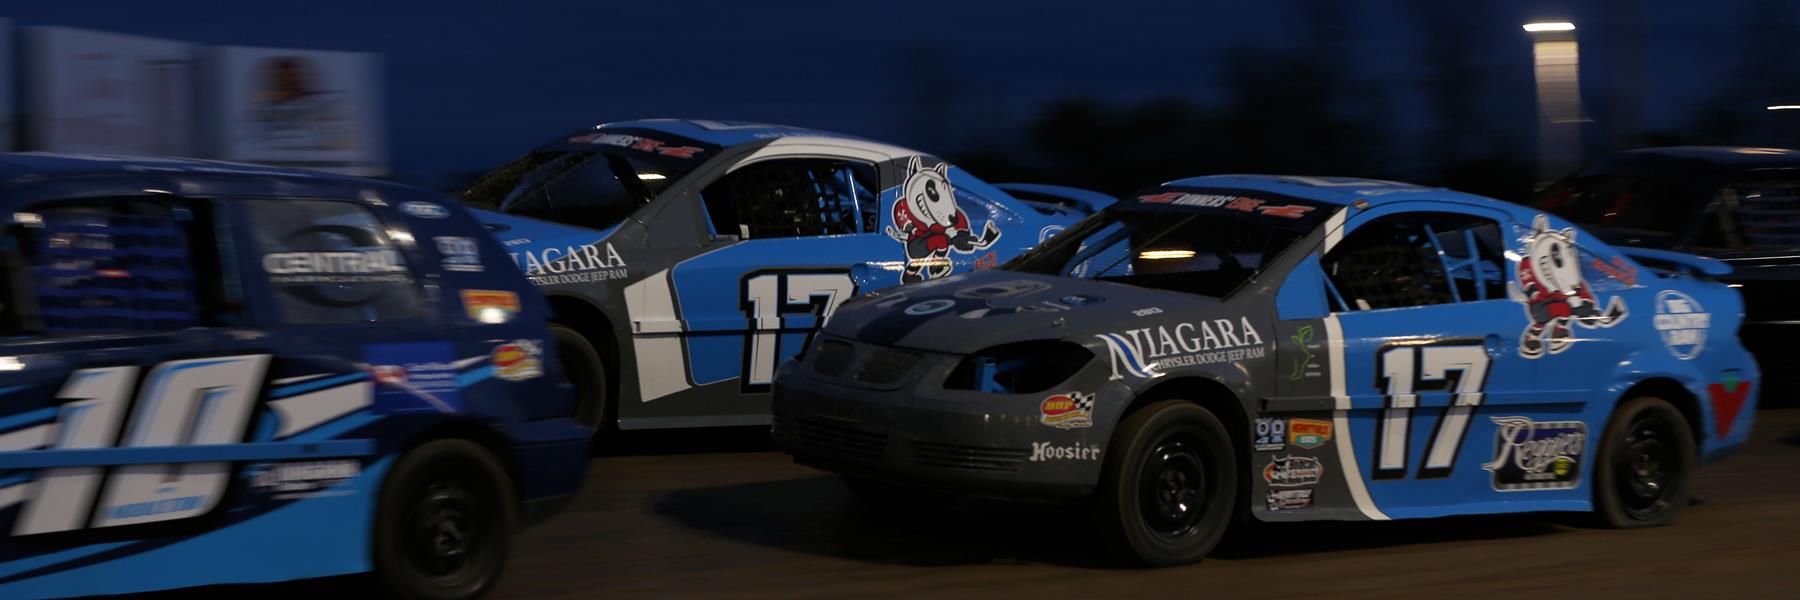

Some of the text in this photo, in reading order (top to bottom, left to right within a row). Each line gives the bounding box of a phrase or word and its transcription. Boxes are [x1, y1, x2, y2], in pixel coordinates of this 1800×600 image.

[560, 272, 590, 284] DODGE
[590, 270, 609, 283] JEEP
[608, 268, 628, 280] RAM
[740, 268, 858, 392] 17
[1095, 315, 1264, 381] NIAGARA
[1153, 346, 1265, 371] CHRYSLER DODGE JEEP RAM
[1373, 337, 1493, 480] 17
[8, 353, 274, 538] 10
[1029, 442, 1101, 462] Hoosier
